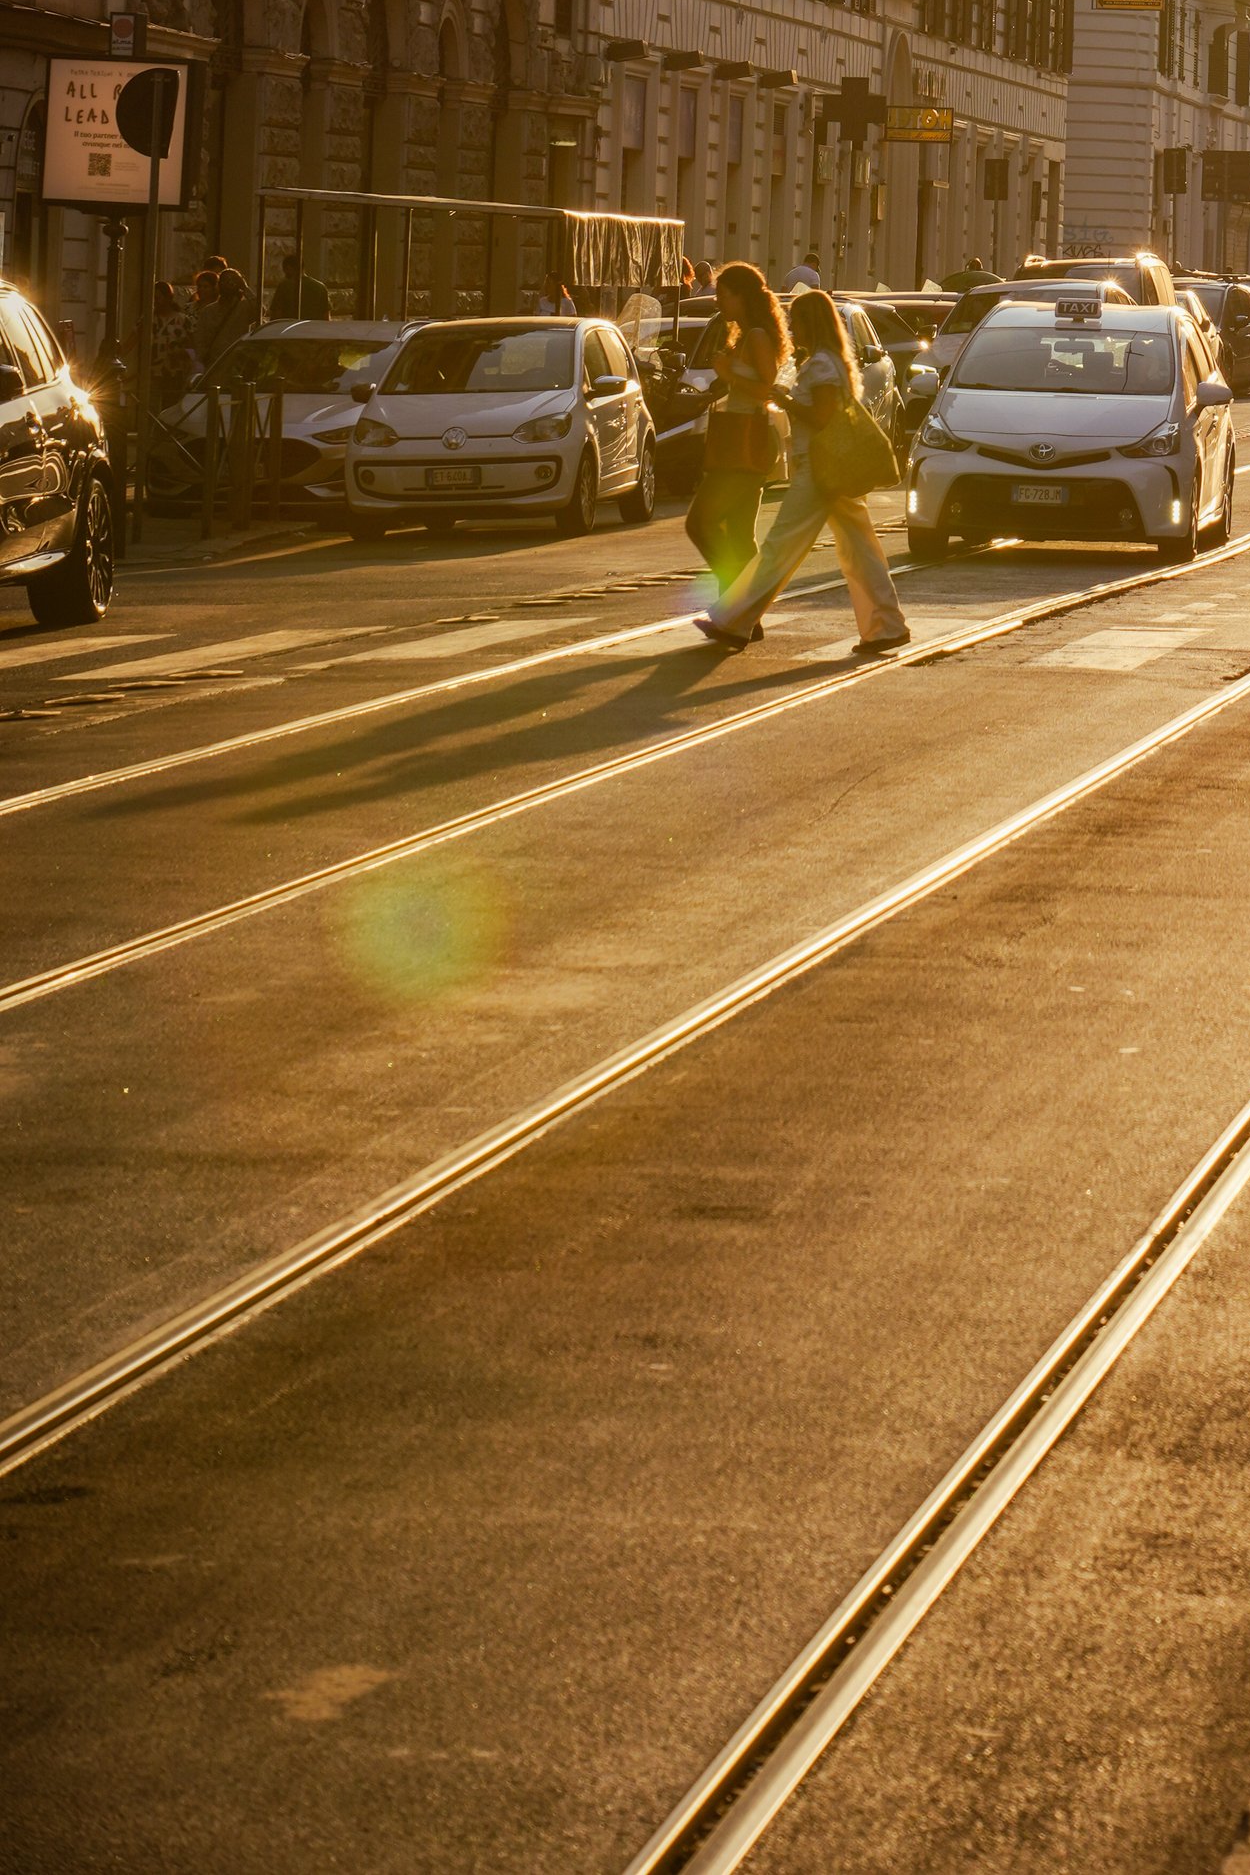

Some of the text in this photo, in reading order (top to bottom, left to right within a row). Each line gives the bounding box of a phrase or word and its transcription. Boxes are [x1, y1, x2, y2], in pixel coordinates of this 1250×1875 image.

[66, 81, 97, 100] ALL
[64, 106, 109, 124] LEAD
[93, 132, 118, 140] partner
[1061, 302, 1095, 313] TAXI
